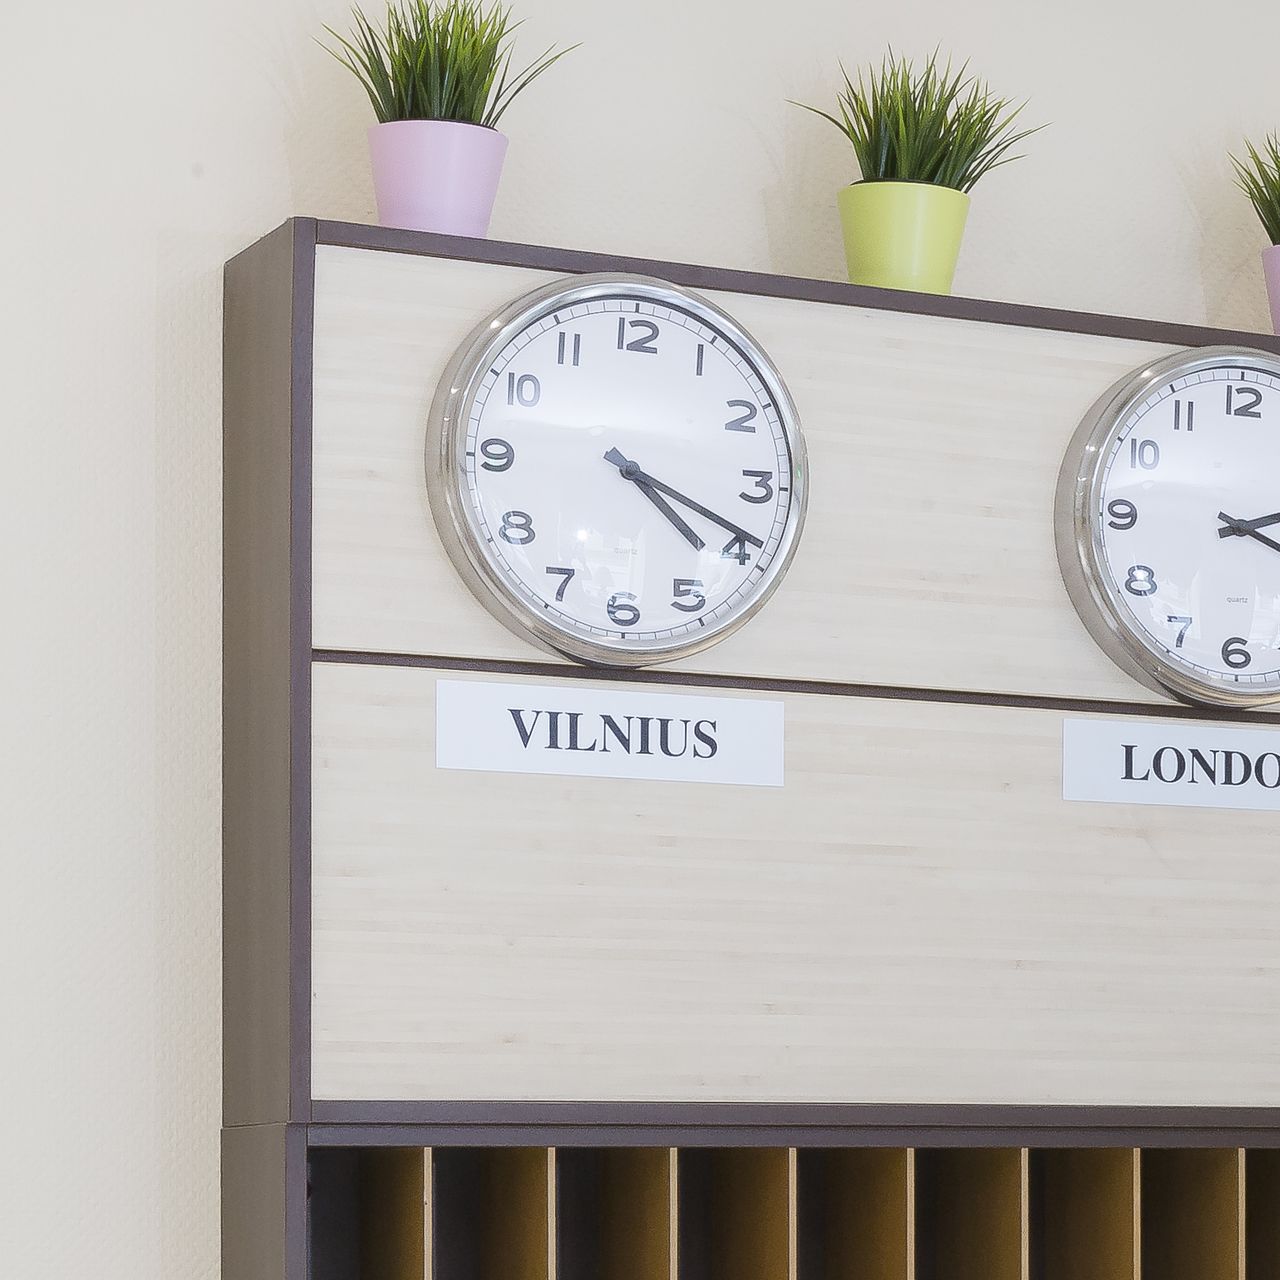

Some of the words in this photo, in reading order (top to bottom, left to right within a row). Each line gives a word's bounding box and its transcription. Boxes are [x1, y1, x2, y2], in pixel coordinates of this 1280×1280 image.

[557, 331, 581, 367] 11
[617, 316, 660, 355] 12
[697, 343, 704, 377] 1
[507, 372, 541, 407] 10
[1225, 385, 1262, 419] 12
[725, 400, 757, 434] 2
[1173, 399, 1194, 432] 11
[480, 438, 515, 472] 9
[1130, 438, 1160, 470] 10
[740, 469, 773, 505] 3
[499, 510, 536, 545] 8
[1107, 499, 1138, 531] 9
[722, 530, 750, 566] 4
[546, 566, 575, 602] 7
[672, 578, 706, 612] 5
[1125, 564, 1158, 597] 8
[606, 591, 642, 627] 6
[1167, 615, 1193, 648] 7
[1221, 636, 1251, 669] 6
[507, 708, 719, 759] VILNIUS
